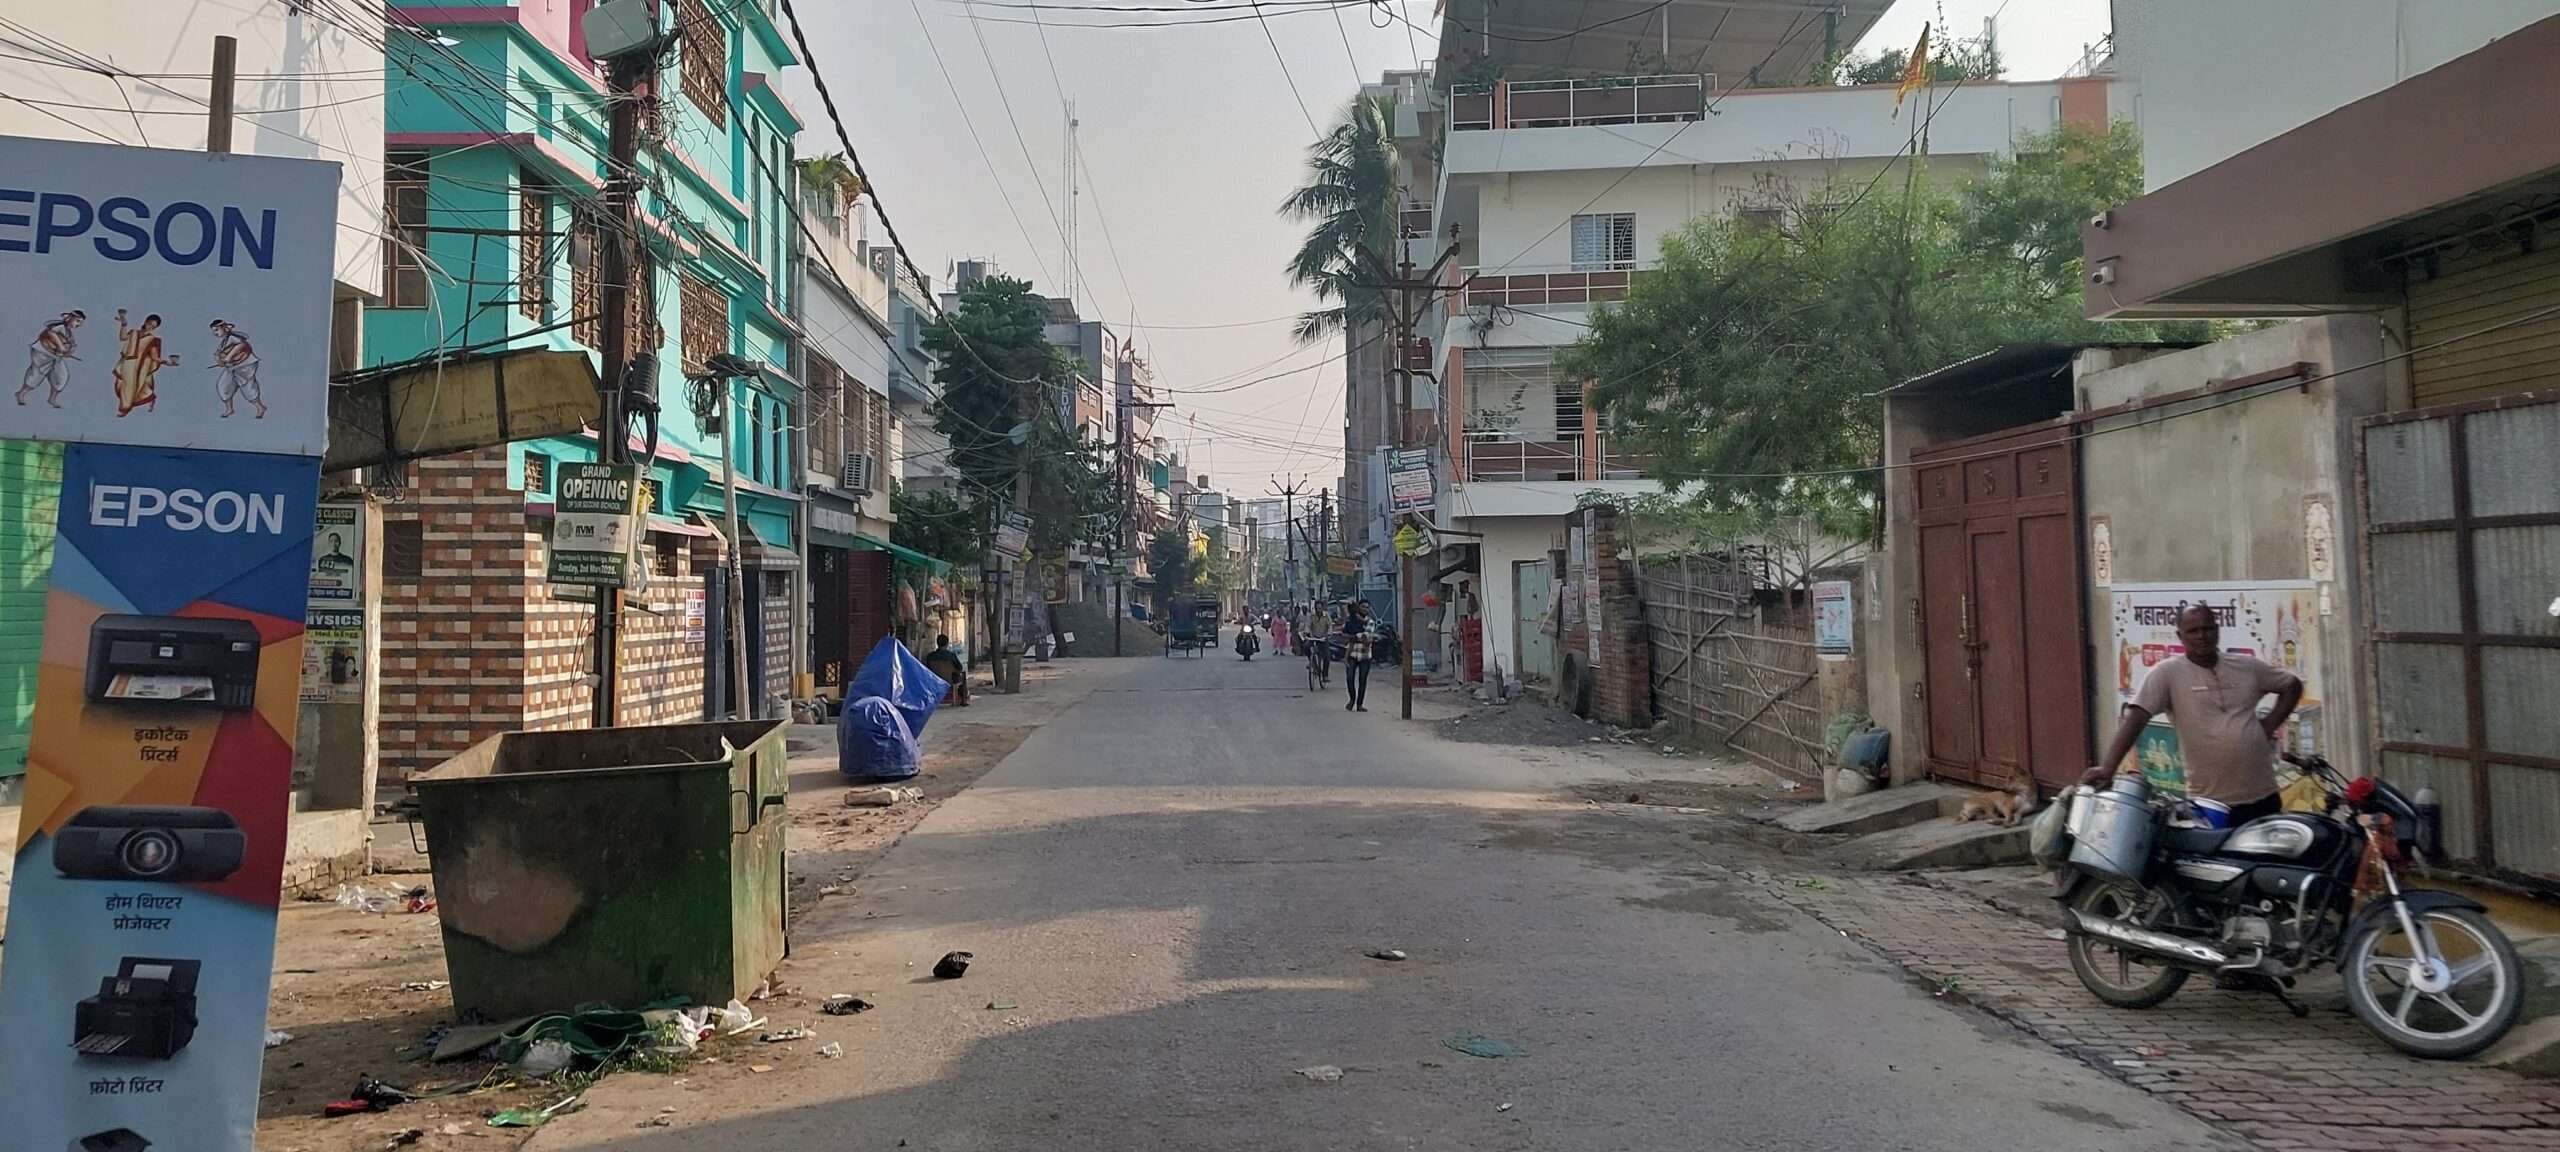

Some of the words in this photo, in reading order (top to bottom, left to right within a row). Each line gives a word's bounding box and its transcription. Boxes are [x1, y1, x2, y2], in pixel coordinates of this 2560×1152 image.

[0, 188, 277, 270] EPSON
[581, 465, 612, 478] GRAND
[563, 478, 628, 500] OPENING
[91, 485, 285, 534] EPSON
[601, 501, 621, 510] SCHOOL
[305, 615, 362, 626] HYSICS
[105, 893, 133, 911] होम
[136, 892, 184, 910] थिएटर
[112, 913, 172, 930] प्रोजेक्टर
[129, 1075, 165, 1094] प्रिंटर
